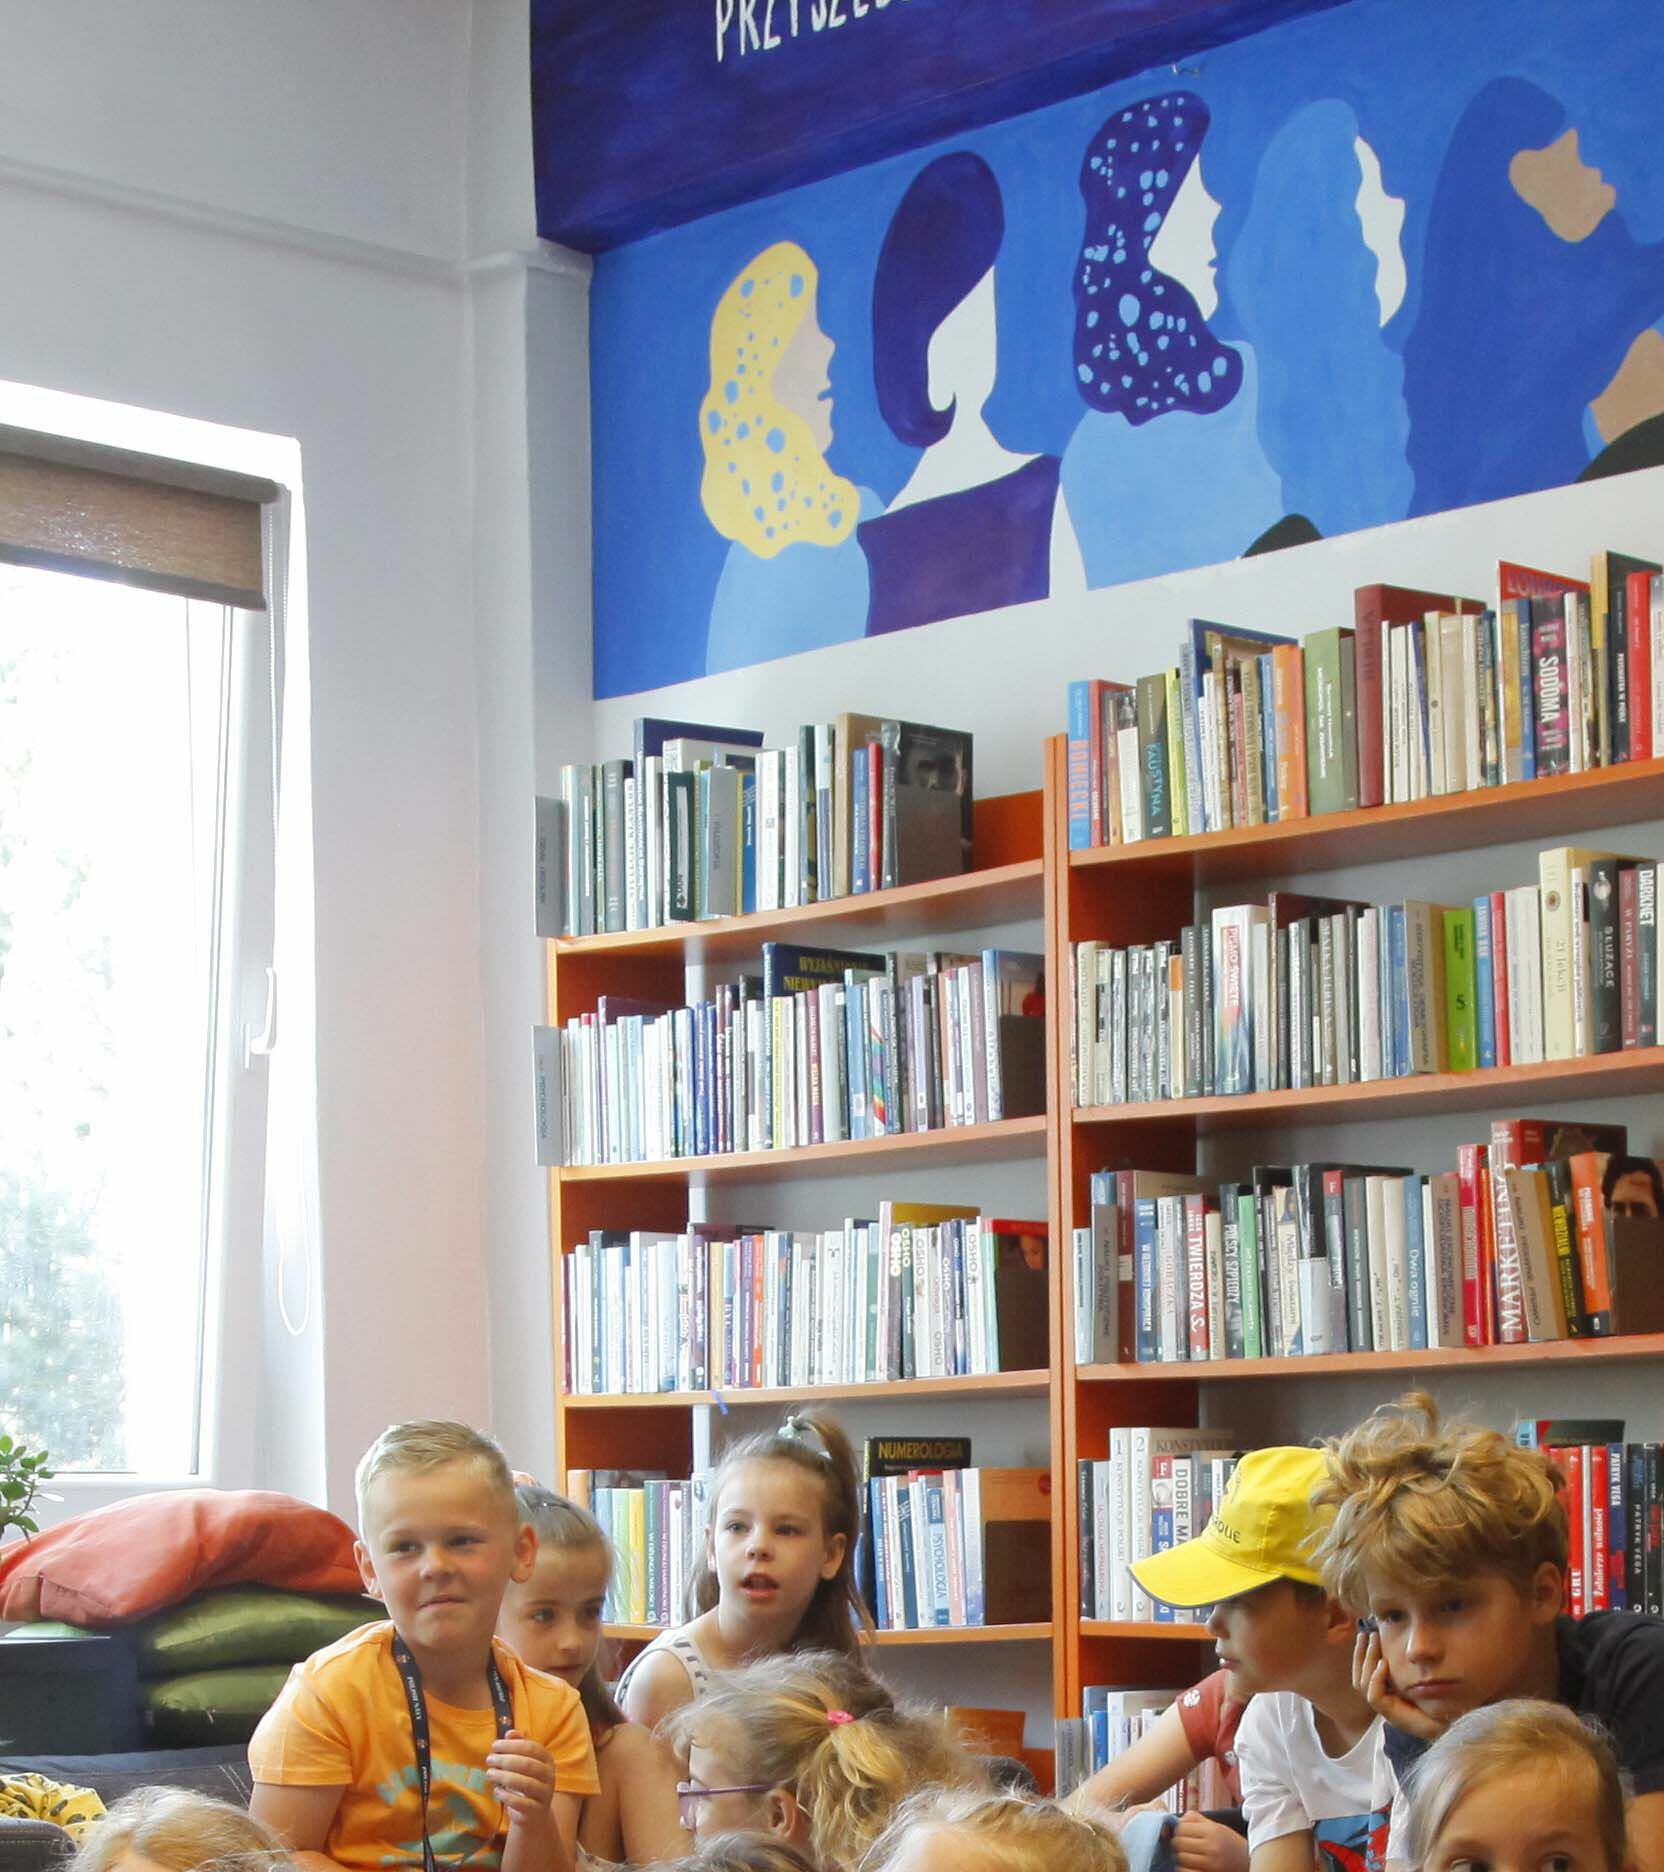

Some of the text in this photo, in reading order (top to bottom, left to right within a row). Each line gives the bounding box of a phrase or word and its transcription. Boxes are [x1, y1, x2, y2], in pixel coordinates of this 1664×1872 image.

[1539, 657, 1560, 722] SODOMA
[1069, 740, 1091, 819] BONIECKI
[1144, 743, 1164, 815] FAUSTYNA
[1639, 869, 1655, 926] DARKNET
[1226, 928, 1241, 963] PISMO
[1602, 926, 1615, 988] SŁUŻĄCE
[889, 1233, 903, 1276] OSHO
[901, 1228, 911, 1267] OSHO
[914, 1239, 926, 1275] OSHO
[968, 1234, 978, 1271] OSHO
[1225, 1224, 1240, 1303] POLSCY SZPIEDZY
[1493, 1158, 1522, 1331] MARKETING
[942, 1257, 951, 1289] OSHO
[1187, 1236, 1204, 1309] TWIERDZA
[1409, 1249, 1426, 1316] Dwa ognie
[933, 1331, 943, 1364] OSHO
[877, 1440, 965, 1460] NUMEROLOGIA
[1136, 1436, 1145, 1452] 2
[1175, 1469, 1189, 1518] DOBRE
[1610, 1452, 1620, 1505] PATRYK VEGA
[933, 1533, 949, 1598] PSYCHOLOGIA
[1633, 1504, 1642, 1574] PATRYK VEGA
